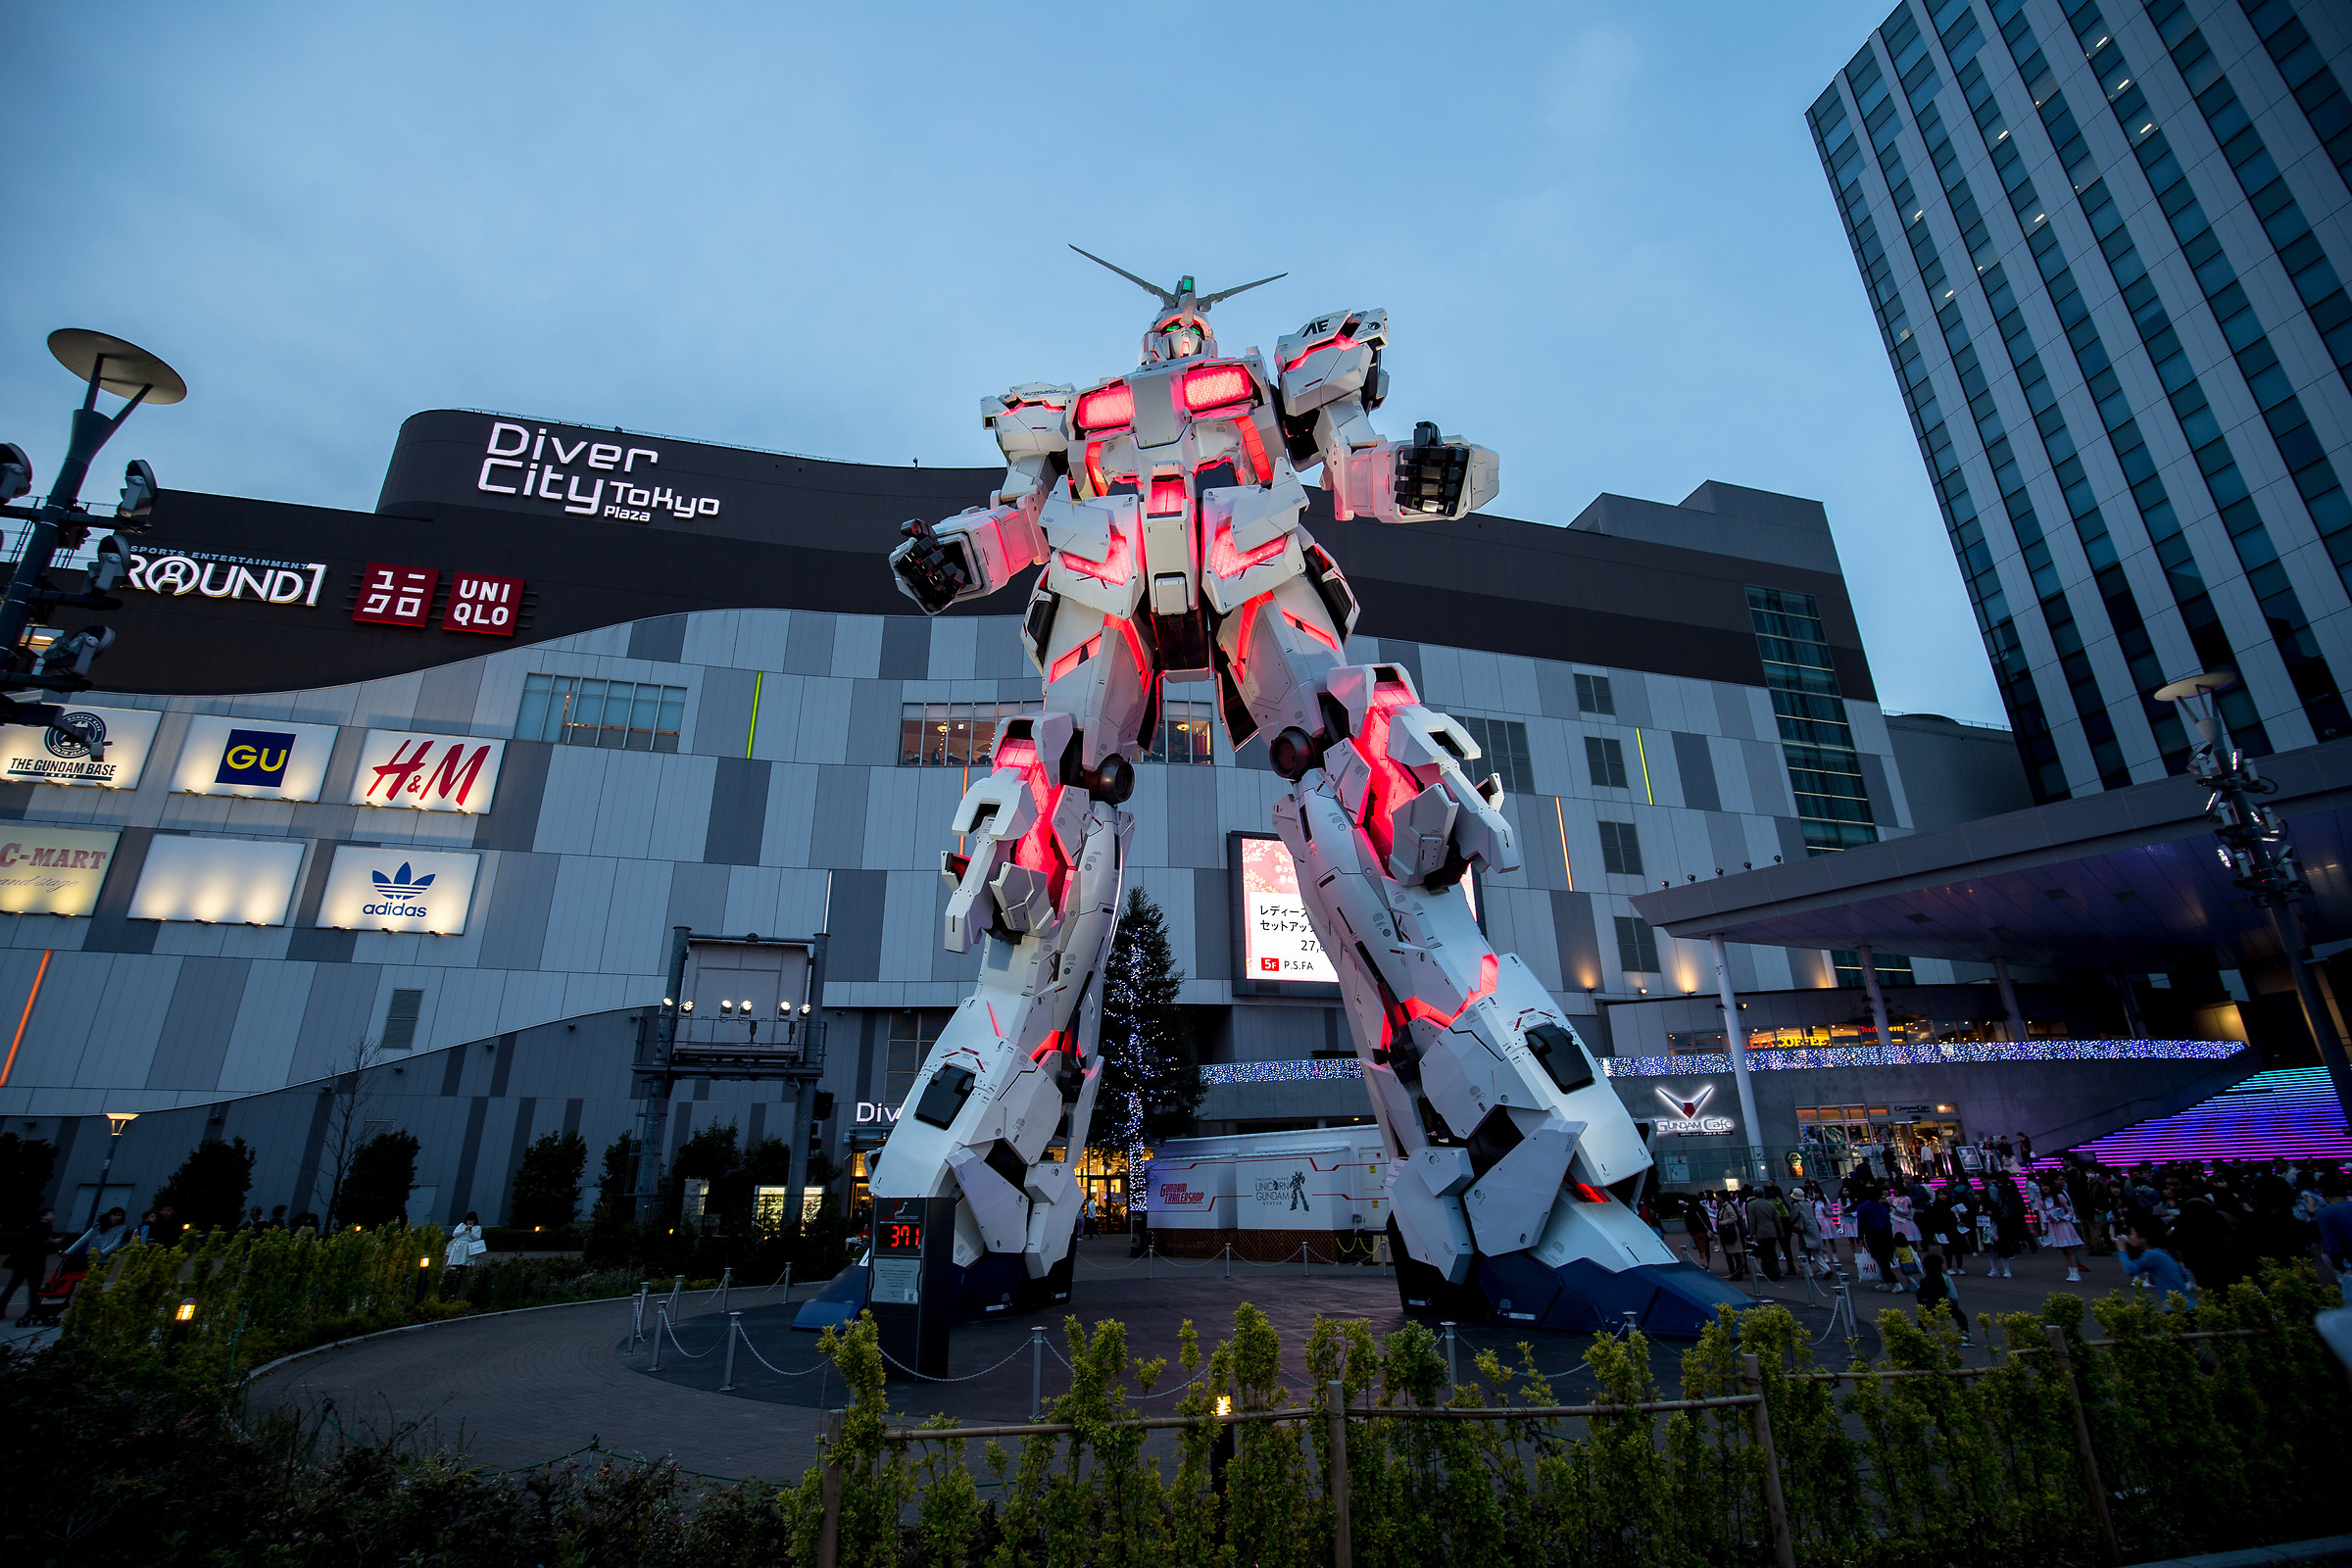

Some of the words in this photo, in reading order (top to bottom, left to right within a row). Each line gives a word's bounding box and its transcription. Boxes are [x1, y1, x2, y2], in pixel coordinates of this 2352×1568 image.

[486, 421, 659, 472] Diver
[477, 457, 605, 515] City
[610, 480, 720, 519] Tokyo
[603, 505, 651, 522] Plaza
[129, 545, 185, 557] SPORTS
[190, 552, 308, 570] ENTERTAINMENT
[459, 579, 511, 603] UNI
[453, 602, 510, 626] QLO
[10, 758, 33, 770] THE
[33, 760, 85, 774] GUNDAM
[85, 762, 117, 776] BASE
[226, 745, 287, 772] GU
[367, 739, 491, 806] H&M
[362, 902, 427, 917] adidas
[1260, 919, 1314, 932] セットアッ
[1264, 958, 1277, 969] 5F
[1284, 960, 1314, 970] P.S.FA
[1255, 1192, 1290, 1200] GUNDAM
[891, 1225, 919, 1248] 371
